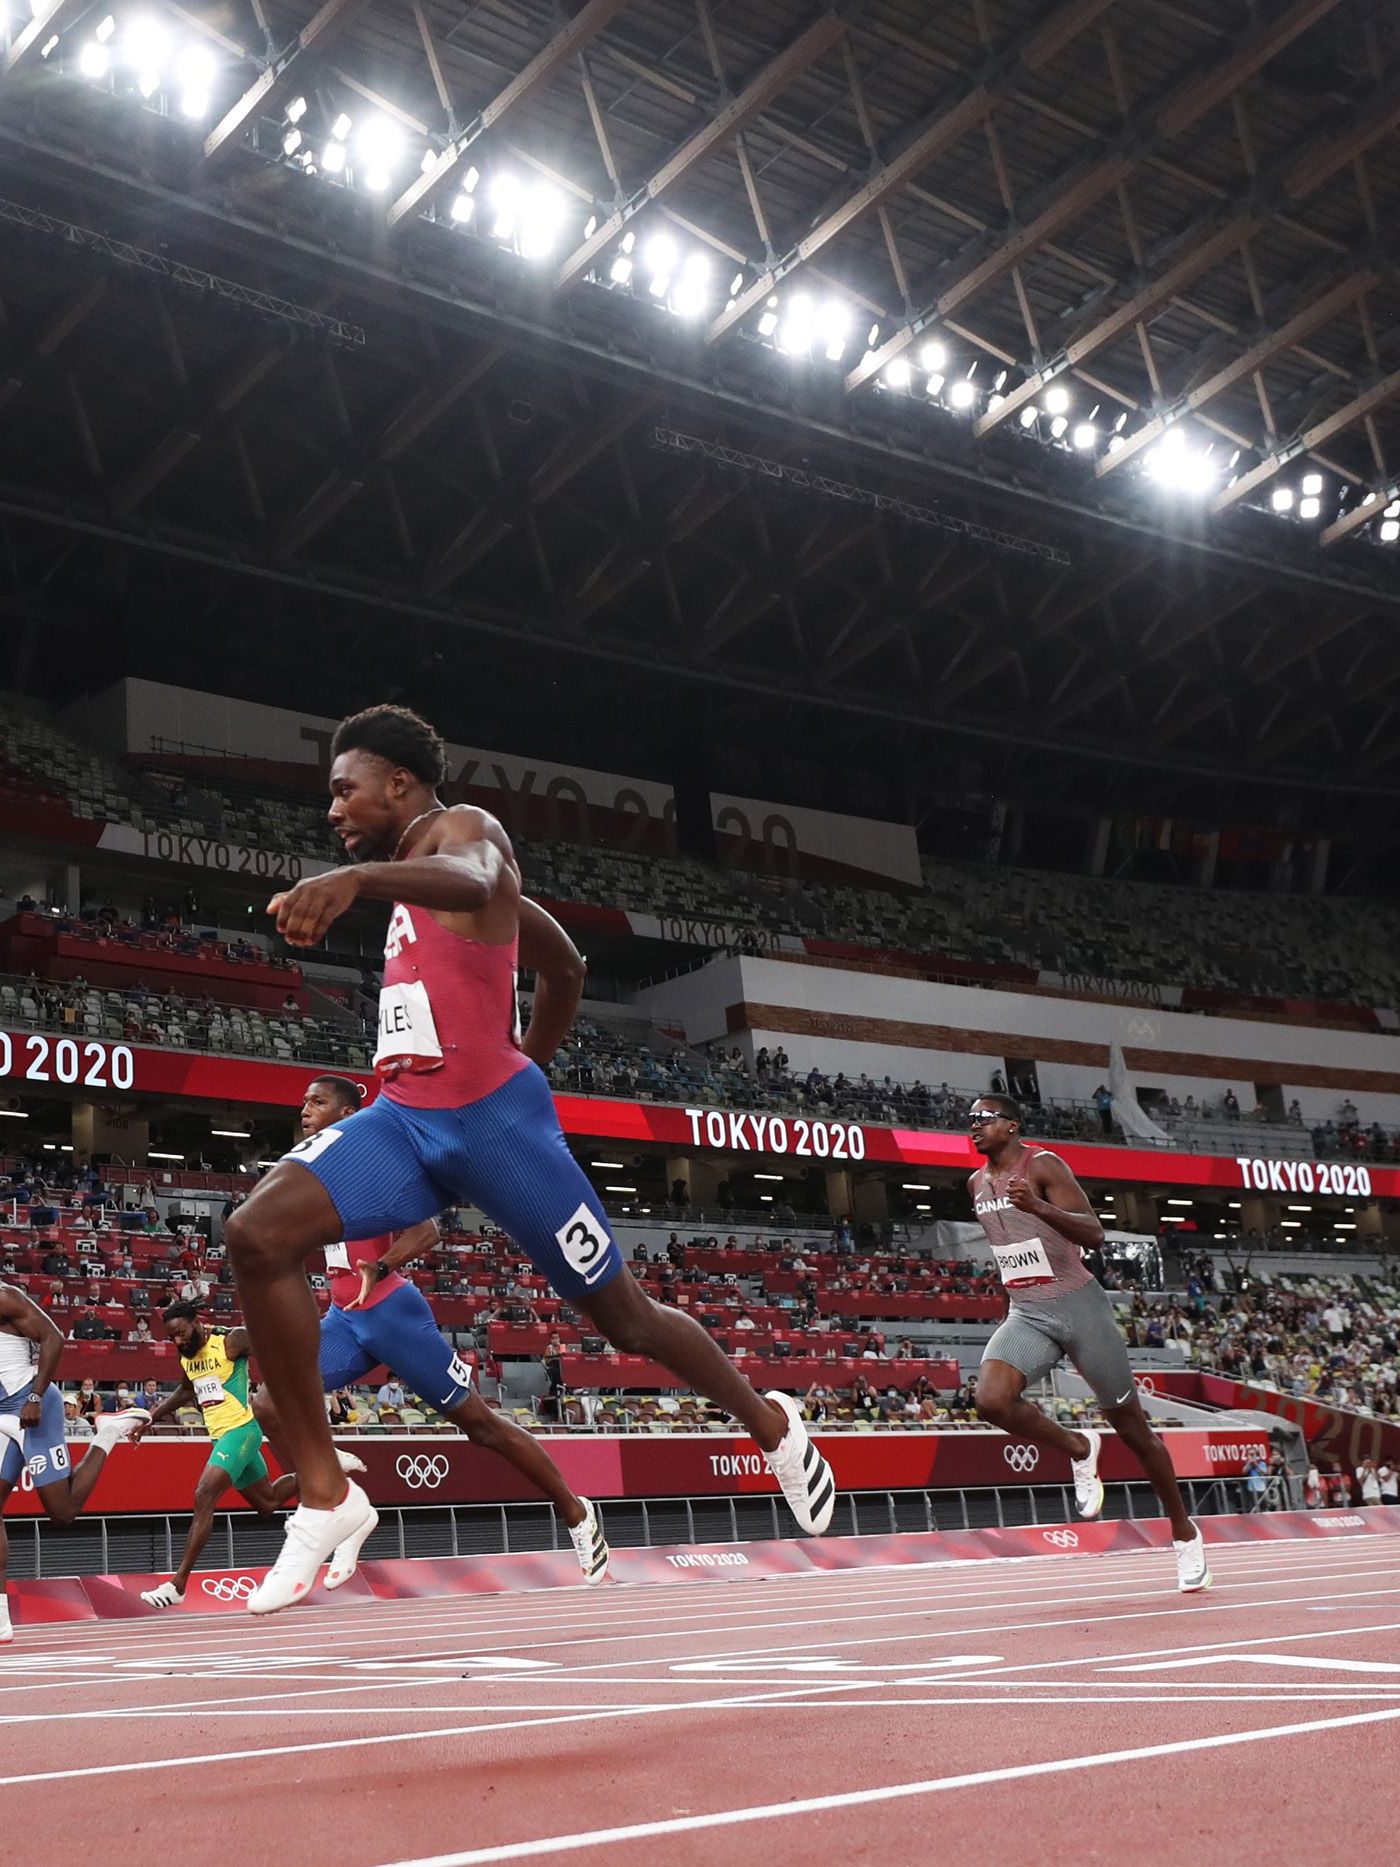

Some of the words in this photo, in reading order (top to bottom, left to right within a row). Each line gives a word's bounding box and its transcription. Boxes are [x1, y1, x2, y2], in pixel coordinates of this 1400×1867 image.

[140, 832, 231, 871] TOKYO
[237, 846, 303, 882] 2020
[384, 903, 418, 960] SA
[660, 917, 725, 947] TOKYO
[1061, 974, 1117, 996] TOKYO
[1118, 980, 1161, 1003] 2020
[25, 1035, 135, 1090] 2020
[685, 1109, 788, 1154] TOKYO
[793, 1119, 865, 1161] 2020
[1236, 1158, 1315, 1194] TOKYO
[1316, 1162, 1371, 1198] 2020
[976, 1196, 1016, 1215] CANAD
[566, 1221, 599, 1264] 3
[998, 1250, 1040, 1268] BROWN
[186, 1357, 221, 1373] JAMAICA
[453, 1360, 467, 1382] 5
[56, 1448, 65, 1466] 8
[710, 1455, 761, 1476] TOKYO
[1203, 1444, 1237, 1462] TOKYO
[666, 1555, 712, 1568] TOKYO
[712, 1553, 749, 1566] 2020
